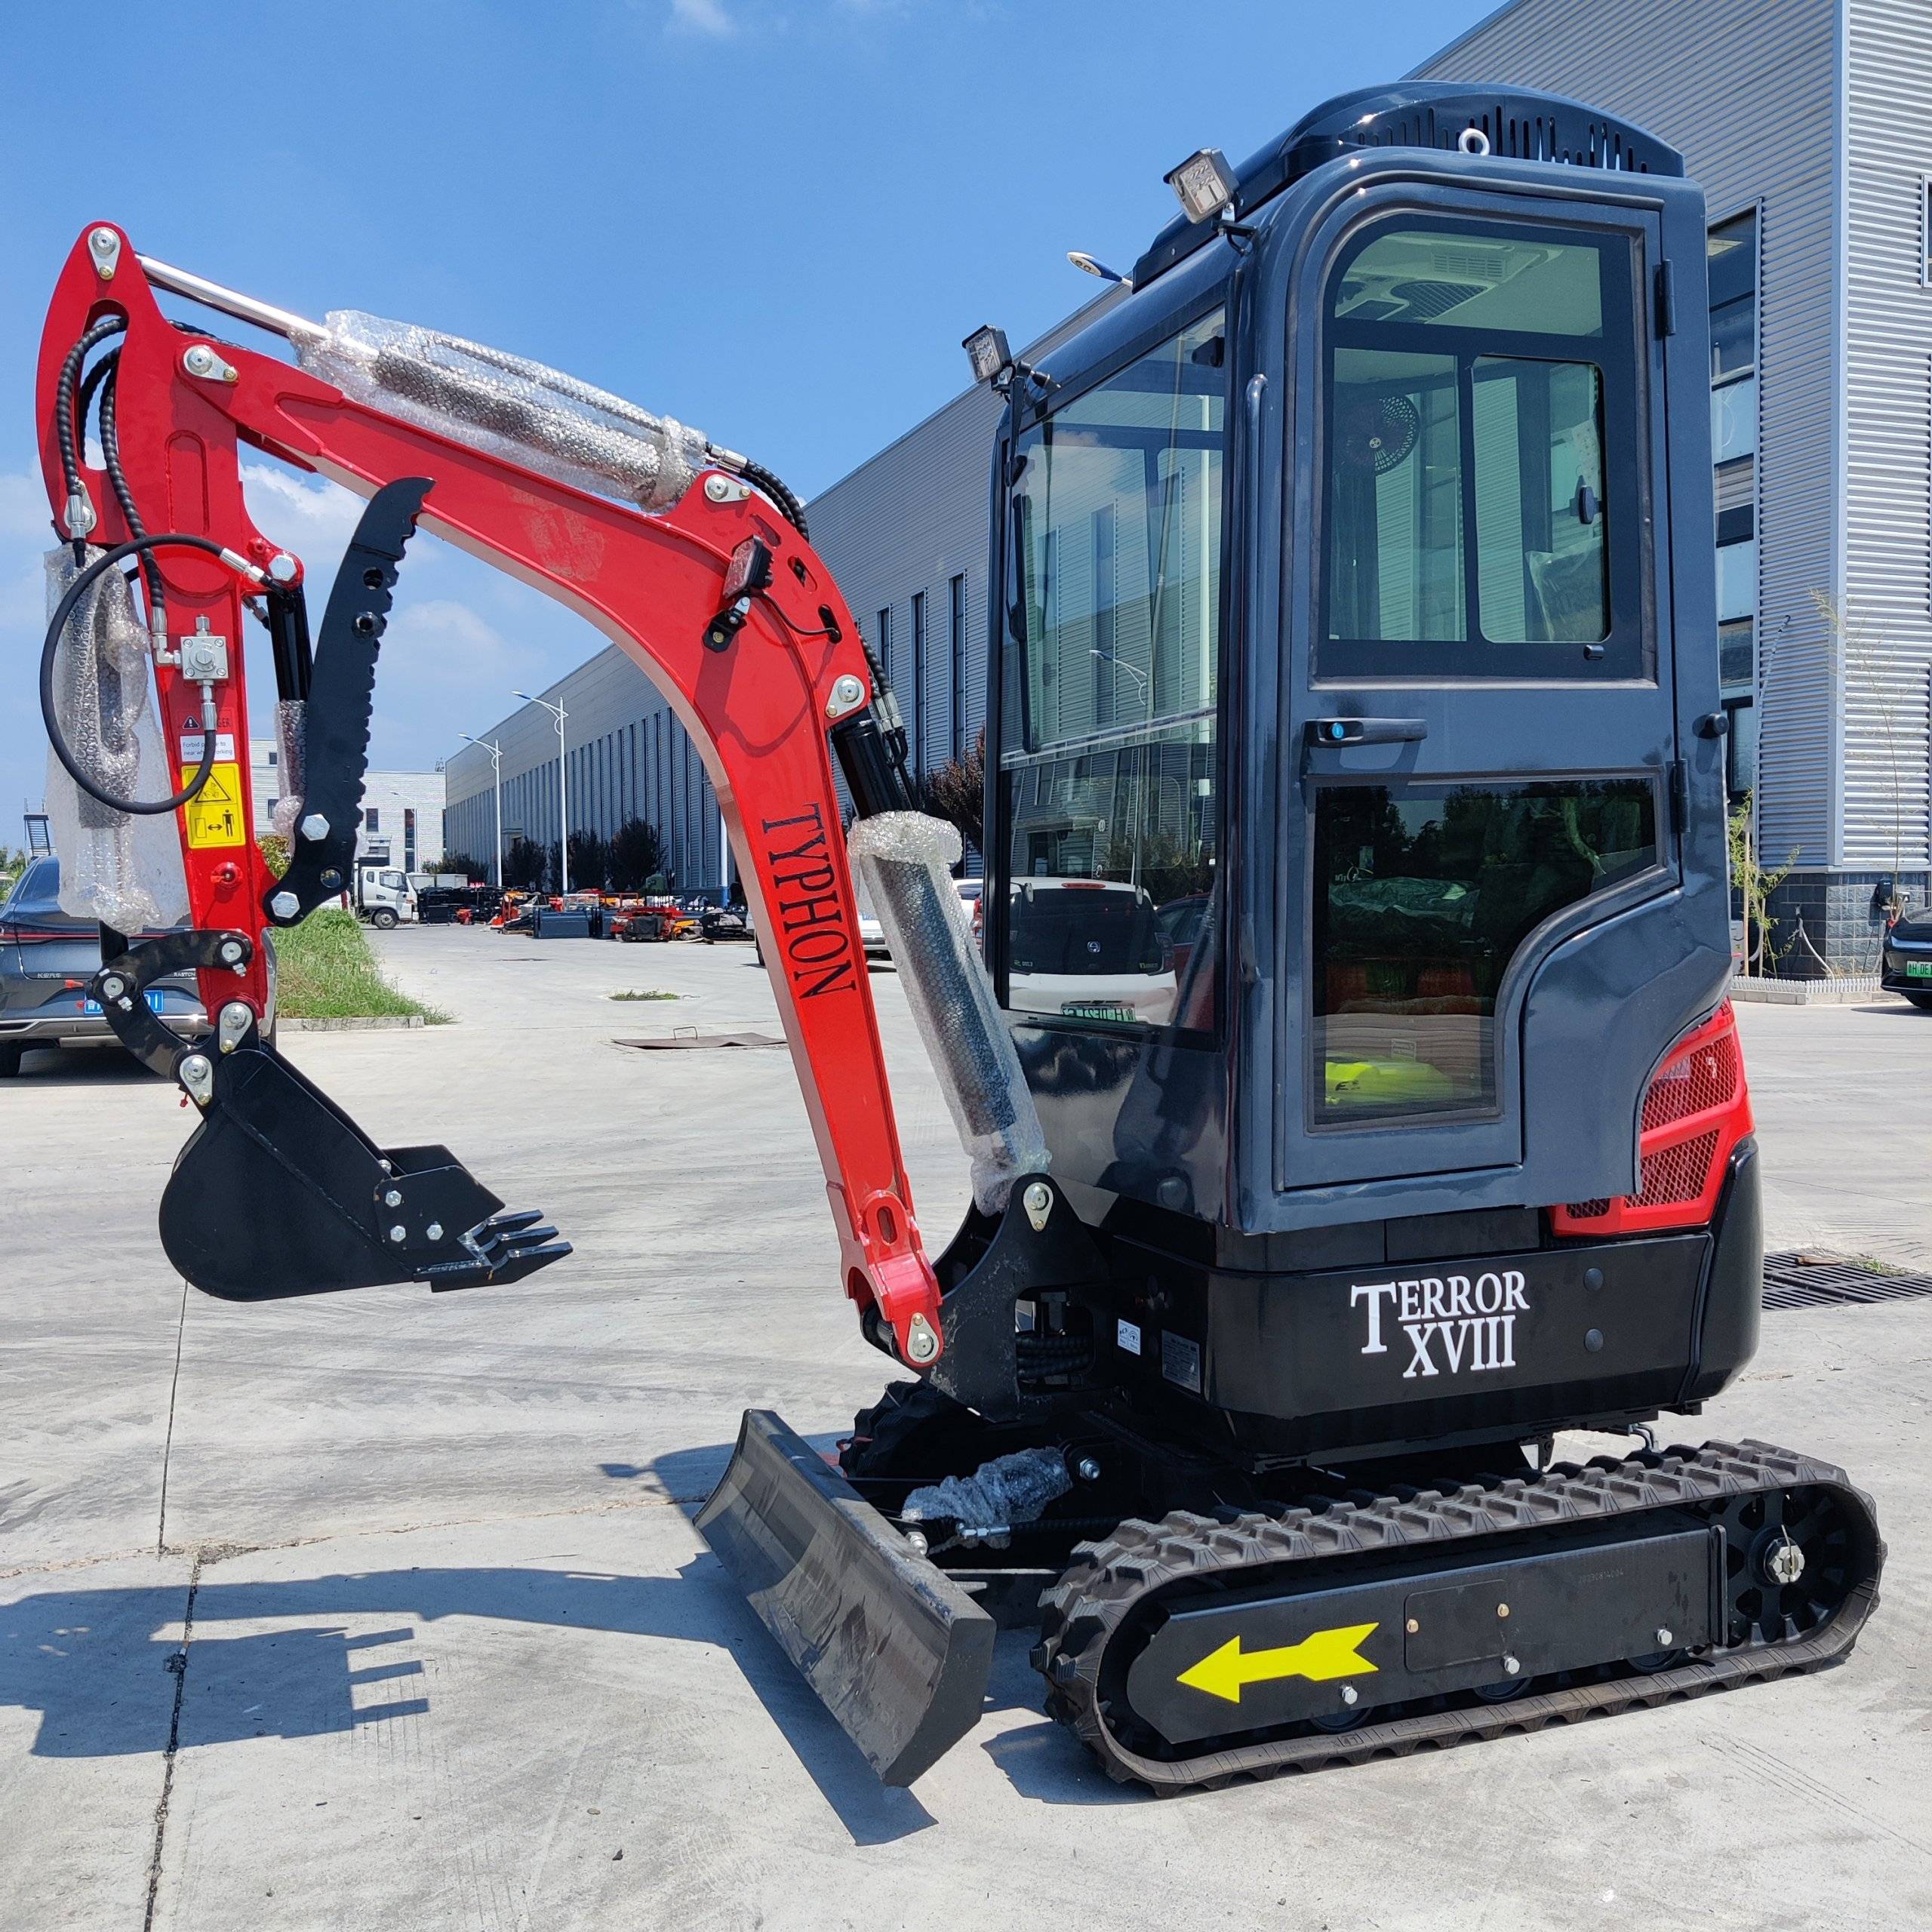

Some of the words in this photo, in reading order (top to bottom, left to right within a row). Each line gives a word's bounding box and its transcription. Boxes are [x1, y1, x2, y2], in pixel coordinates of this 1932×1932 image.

[761, 802, 857, 1000] TYPHON
[1350, 1270, 1531, 1355] TERROR
[1402, 1315, 1516, 1378] XVIII
